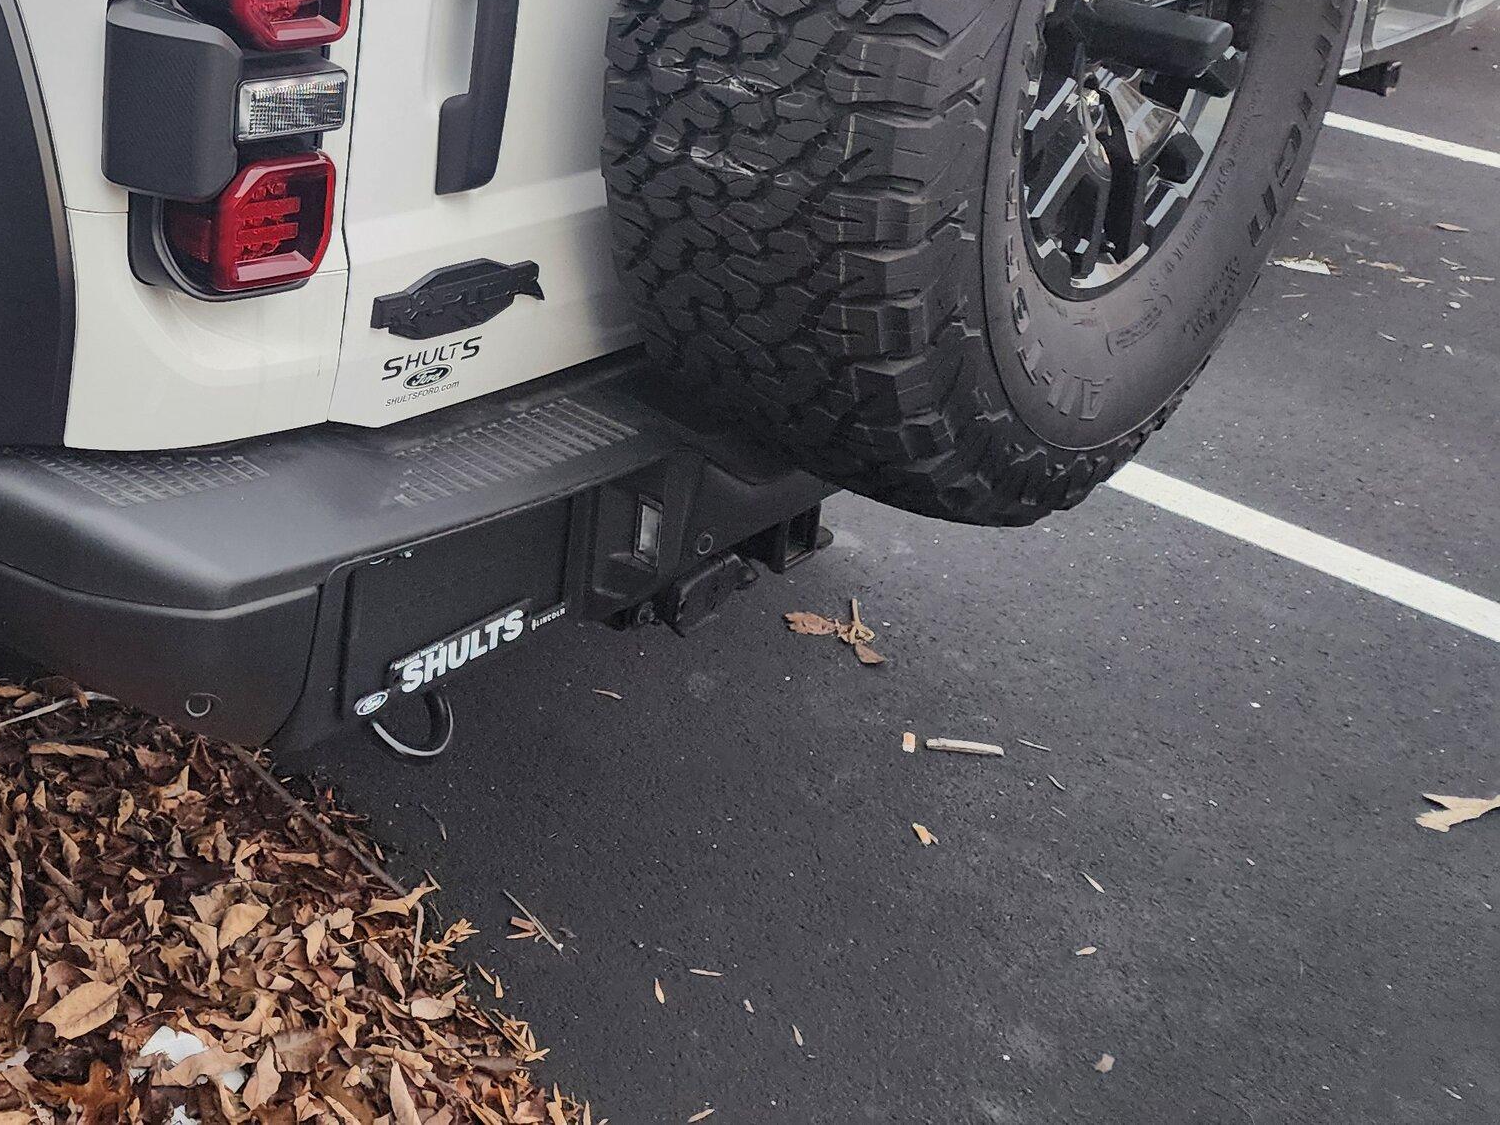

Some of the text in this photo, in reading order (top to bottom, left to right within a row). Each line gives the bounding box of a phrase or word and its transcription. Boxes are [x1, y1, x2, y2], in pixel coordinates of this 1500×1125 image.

[370, 259, 545, 331] RAPTOR
[381, 336, 482, 381] SHULTS
[385, 381, 460, 407] SHULTSFORD.com
[536, 607, 566, 627] LINCOLN
[401, 609, 524, 693] SHULTS
